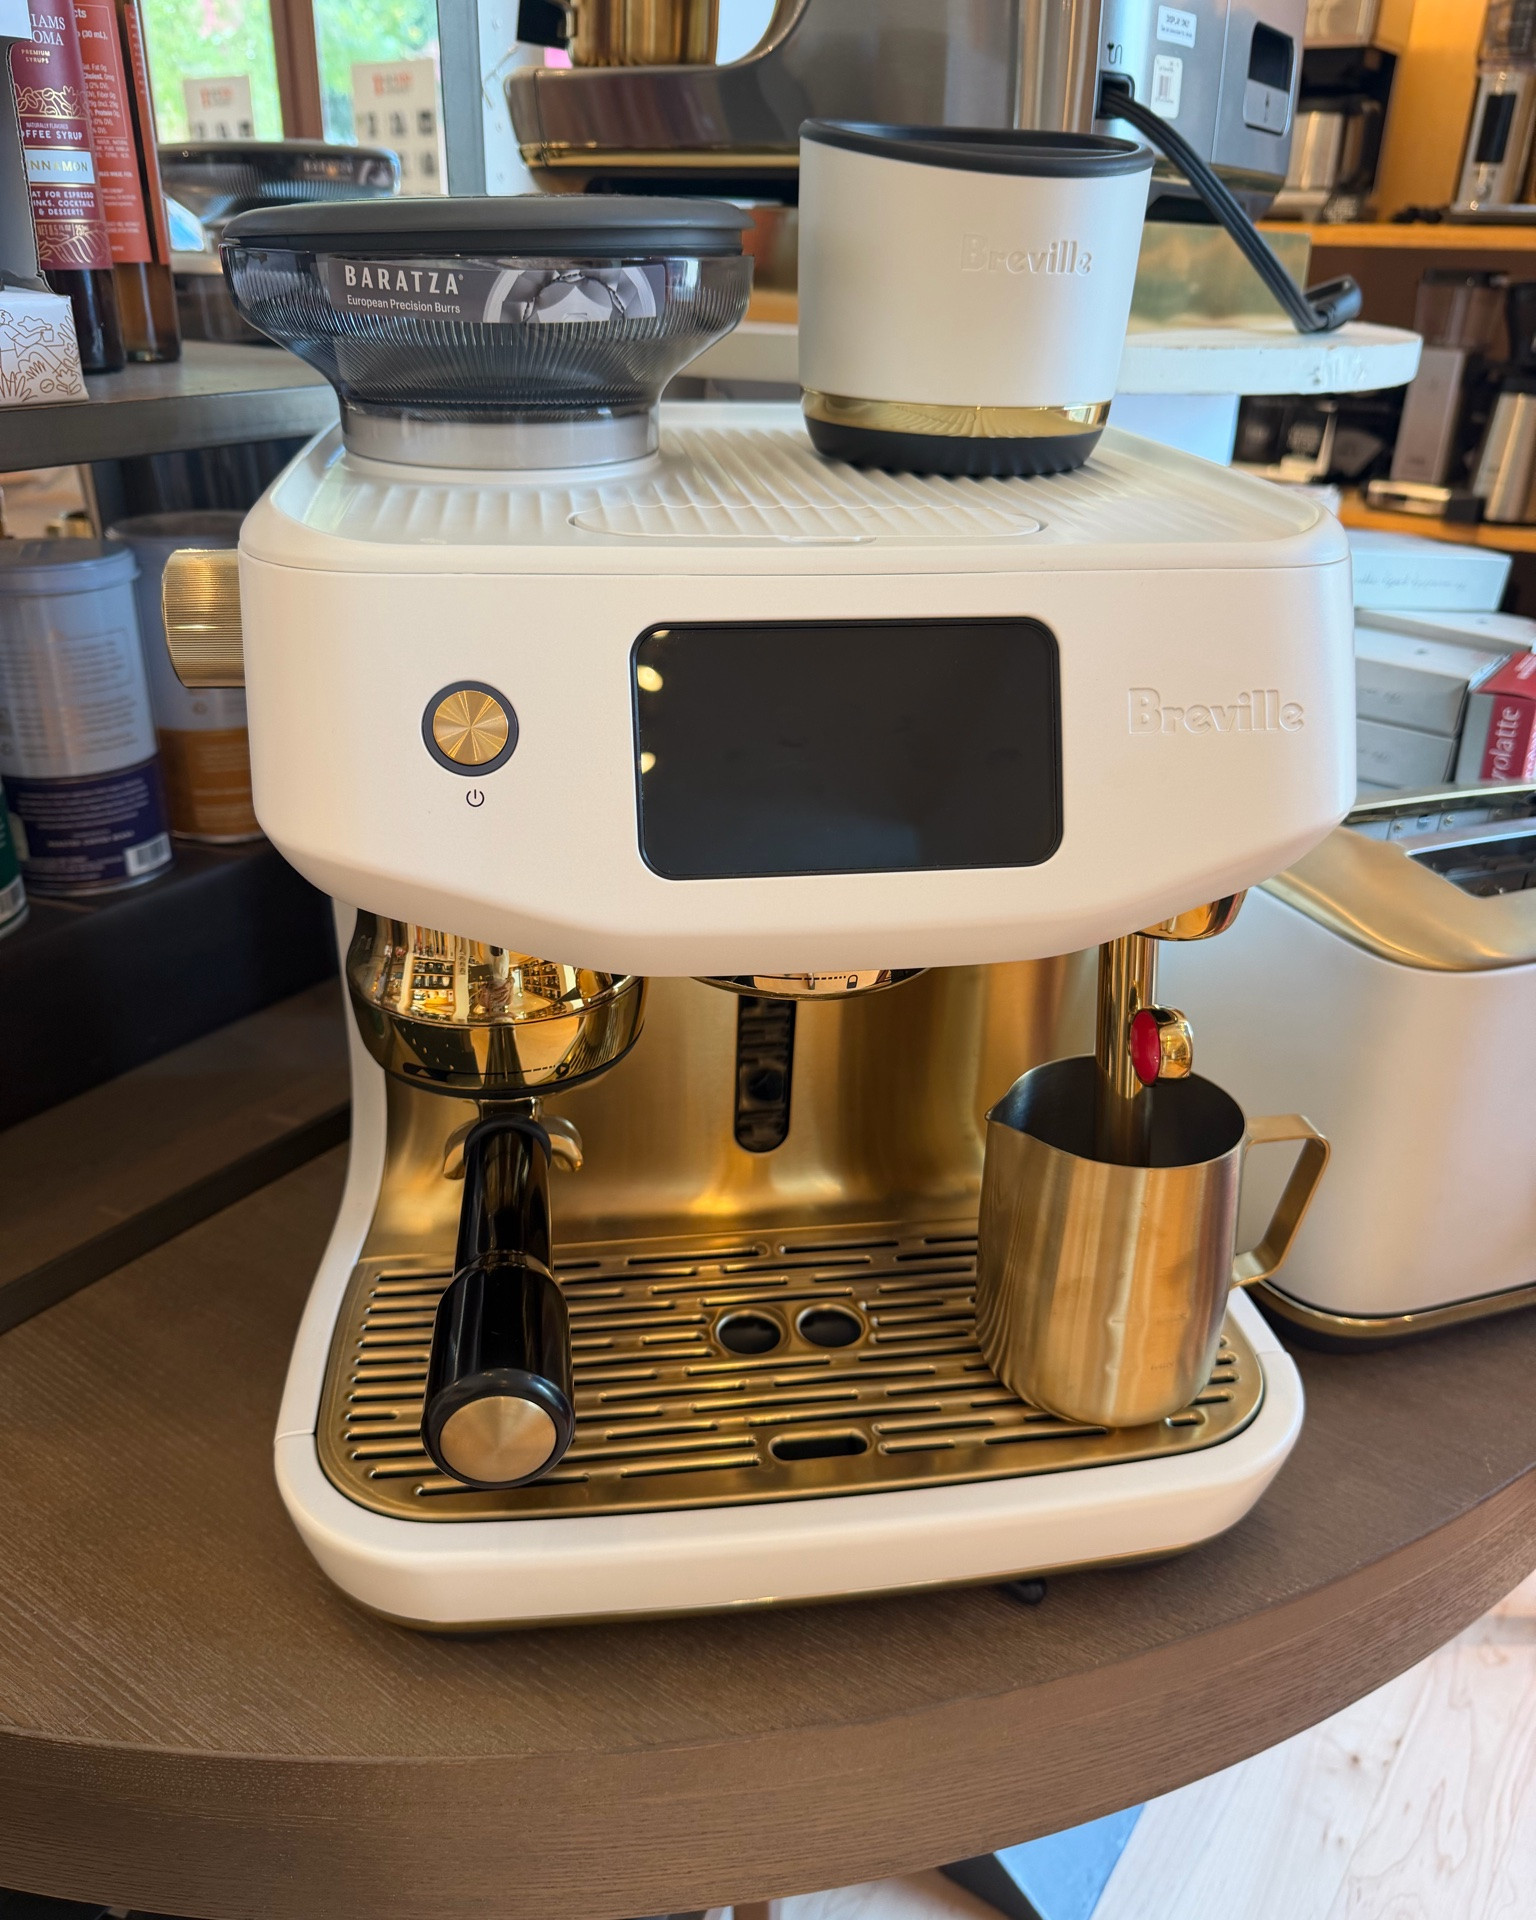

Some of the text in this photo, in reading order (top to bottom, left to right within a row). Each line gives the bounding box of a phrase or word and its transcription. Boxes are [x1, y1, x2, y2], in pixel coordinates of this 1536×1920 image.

[74, 8, 87, 18] cts
[31, 13, 66, 30] IAMS
[32, 29, 64, 46] OMA
[20, 49, 51, 57] PREMIUM
[55, 130, 83, 141] SYRUP
[30, 160, 88, 172] NNAMON
[44, 190, 61, 198] FOR
[63, 191, 95, 199] ESPRESSO
[57, 199, 95, 208] COCKTAILS
[47, 208, 84, 216] DESSERTS
[960, 232, 1093, 277] Breville
[344, 264, 460, 296] BARATZA
[346, 294, 461, 314] European Precision Burrs
[1128, 687, 1305, 735] Breville
[1488, 706, 1520, 780] rolatte
